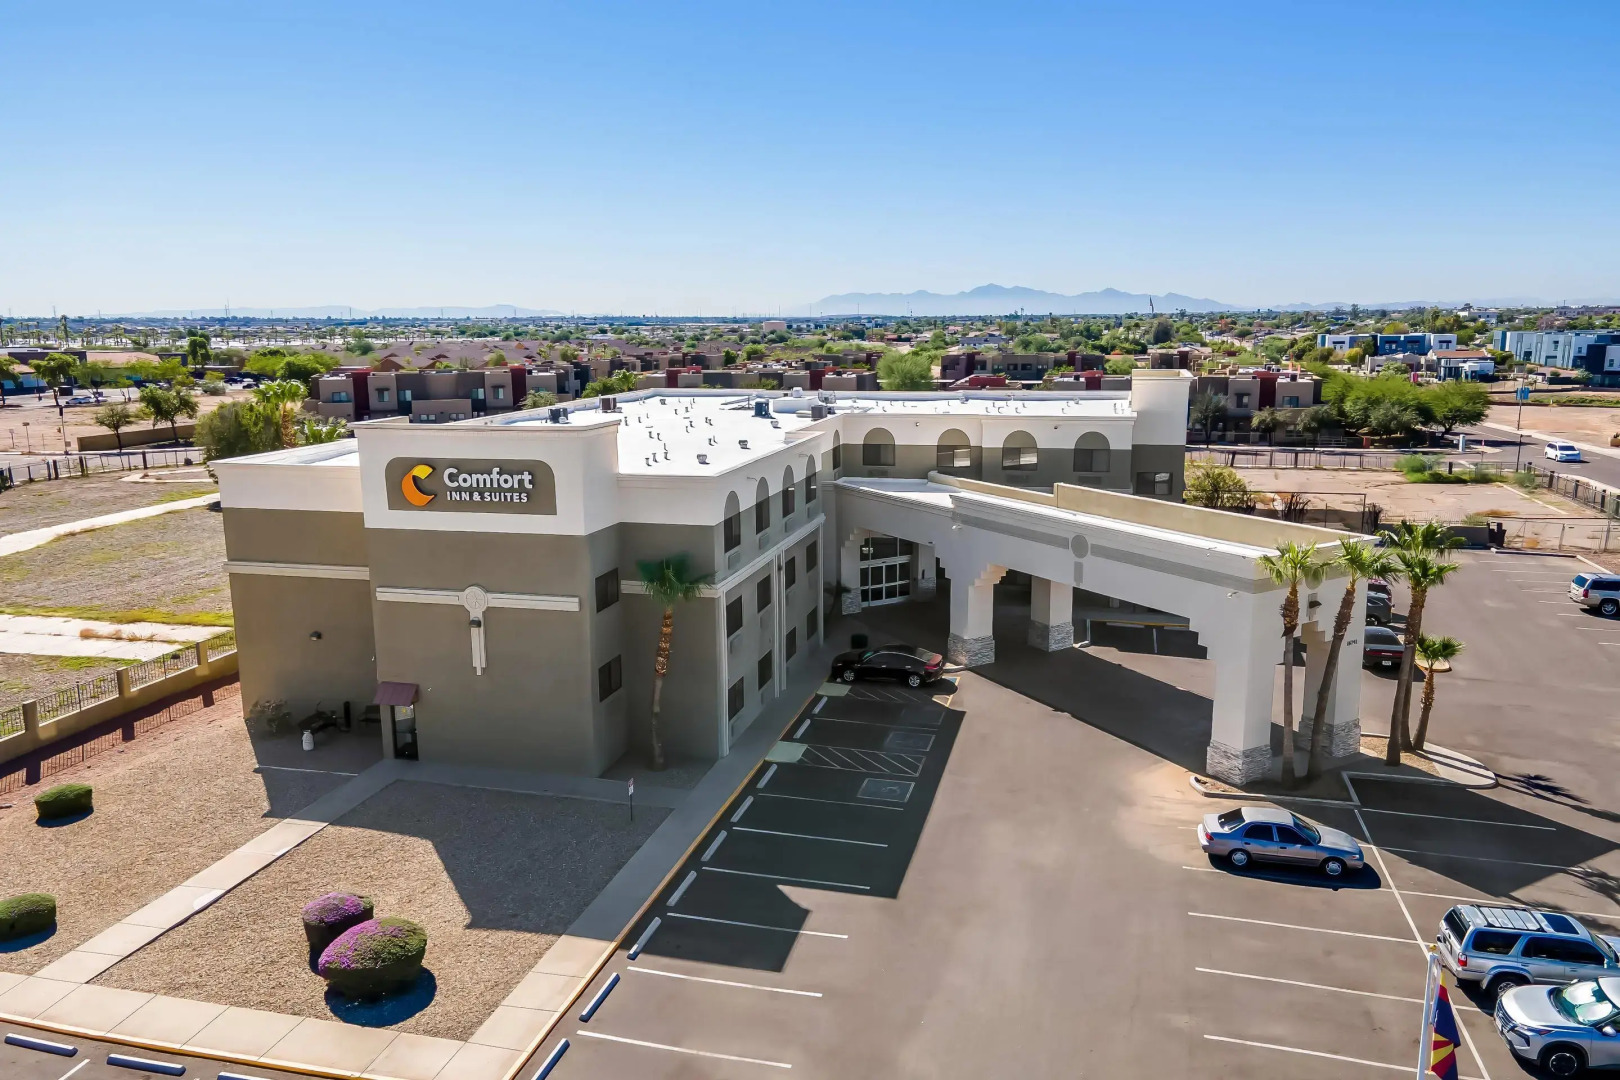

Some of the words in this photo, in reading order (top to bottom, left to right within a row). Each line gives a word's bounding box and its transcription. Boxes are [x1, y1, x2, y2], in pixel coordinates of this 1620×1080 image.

[443, 467, 533, 489] Comfort
[446, 491, 470, 501] INN
[472, 491, 481, 501] &
[484, 492, 528, 503] SUITES
